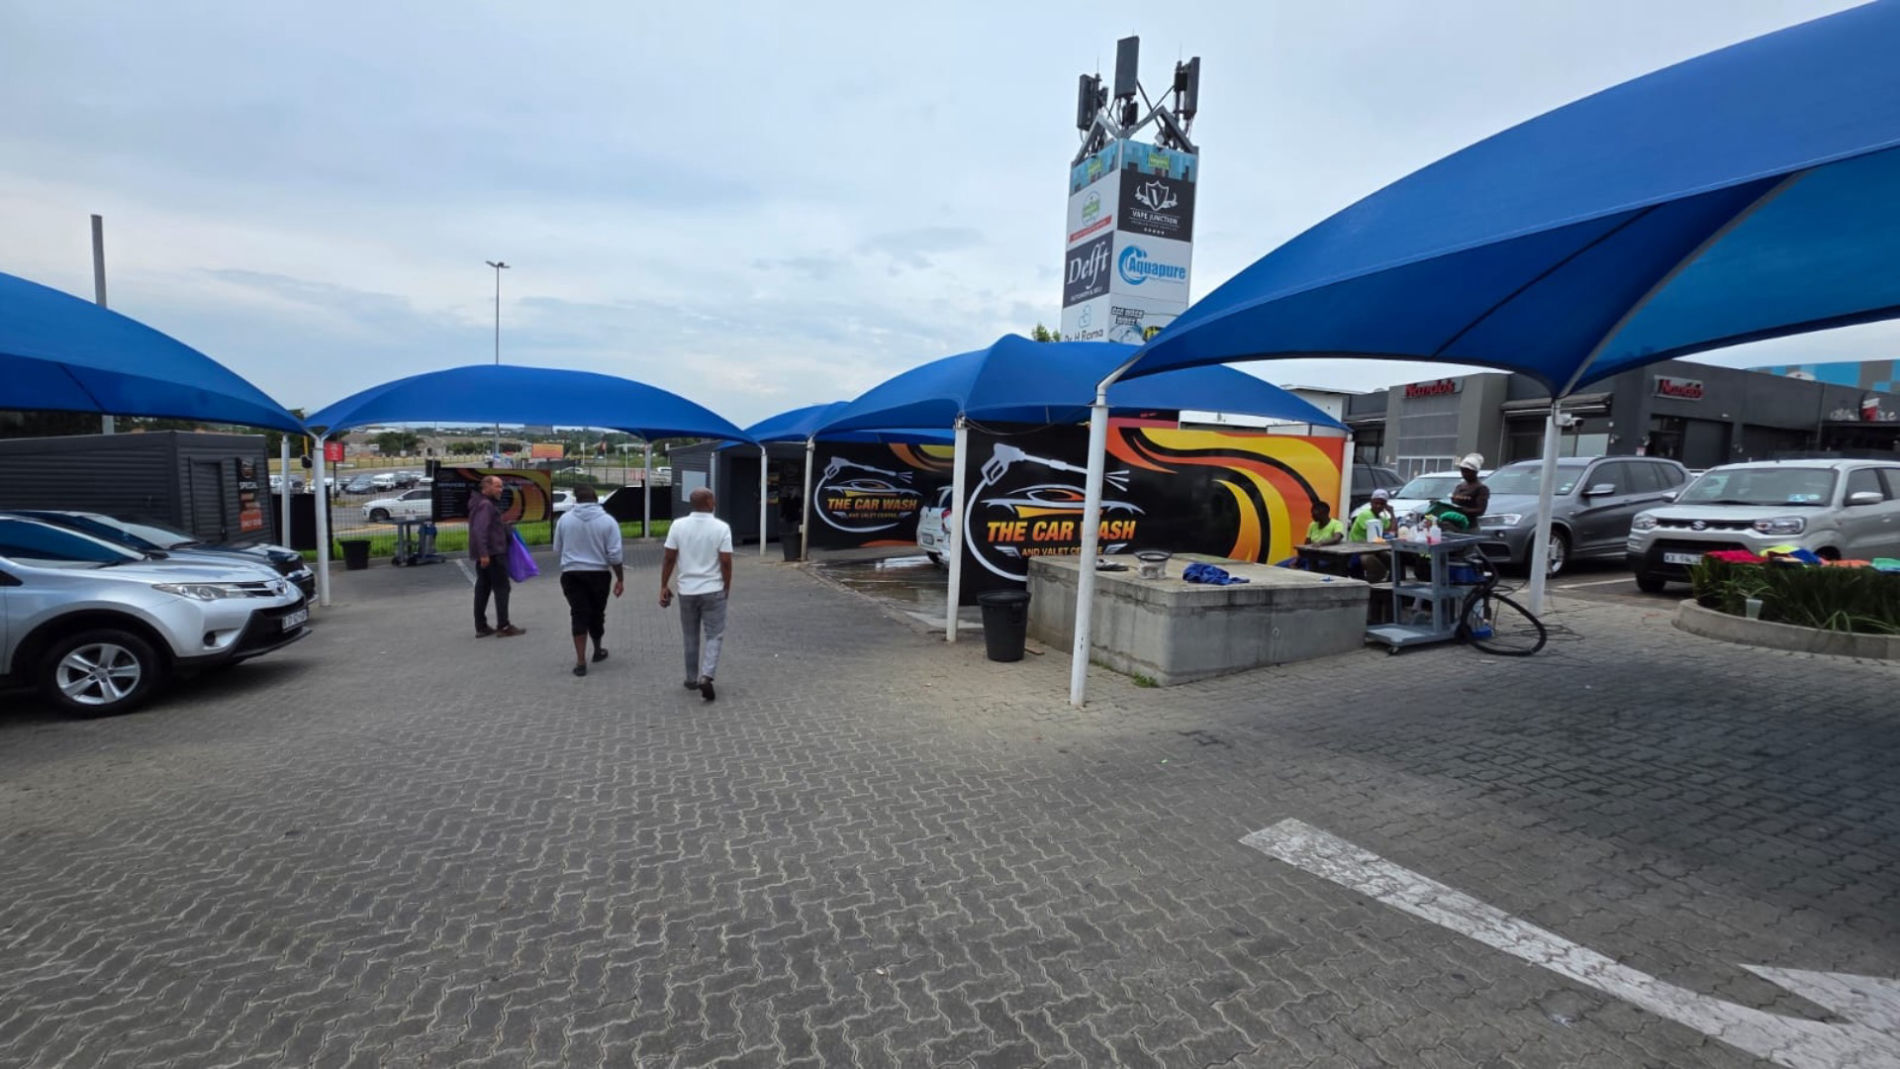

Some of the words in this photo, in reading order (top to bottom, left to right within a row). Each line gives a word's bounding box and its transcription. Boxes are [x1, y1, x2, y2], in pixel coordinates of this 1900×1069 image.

[1132, 210, 1148, 220] VAPE
[1149, 213, 1178, 225] JUNCTION
[1066, 241, 1110, 290] Delft
[1128, 256, 1186, 280] Aquapure
[827, 498, 851, 510] THE
[854, 498, 879, 510] CAR
[882, 498, 917, 510] WASH
[987, 521, 1029, 543] THE
[1032, 520, 1076, 542] CAR
[1079, 520, 1136, 542] ASH
[1021, 547, 1040, 557] AND
[1041, 547, 1069, 556] VALET
